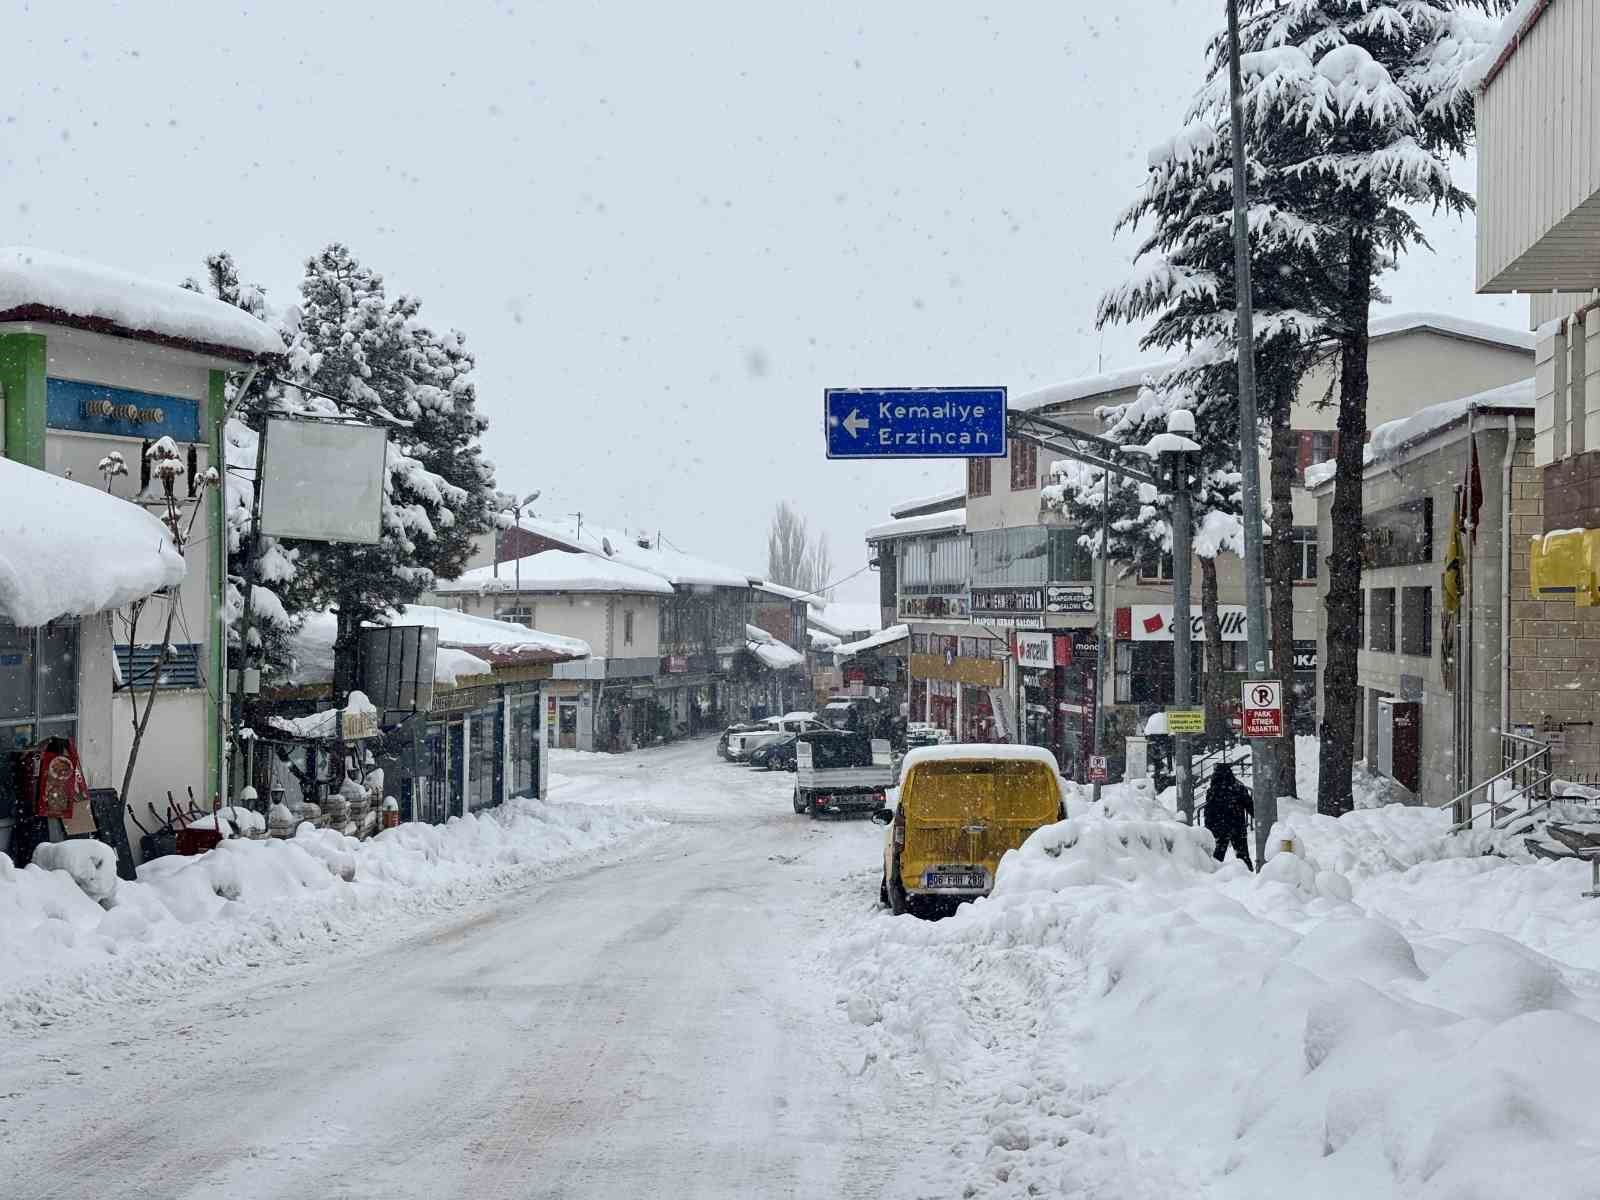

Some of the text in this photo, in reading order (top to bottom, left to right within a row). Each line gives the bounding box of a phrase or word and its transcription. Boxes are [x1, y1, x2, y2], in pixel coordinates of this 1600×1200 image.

[878, 402, 985, 422] Kemaliye
[879, 428, 989, 445] Erzincan
[1168, 611, 1248, 639] çlik
[1253, 710, 1272, 718] PARK
